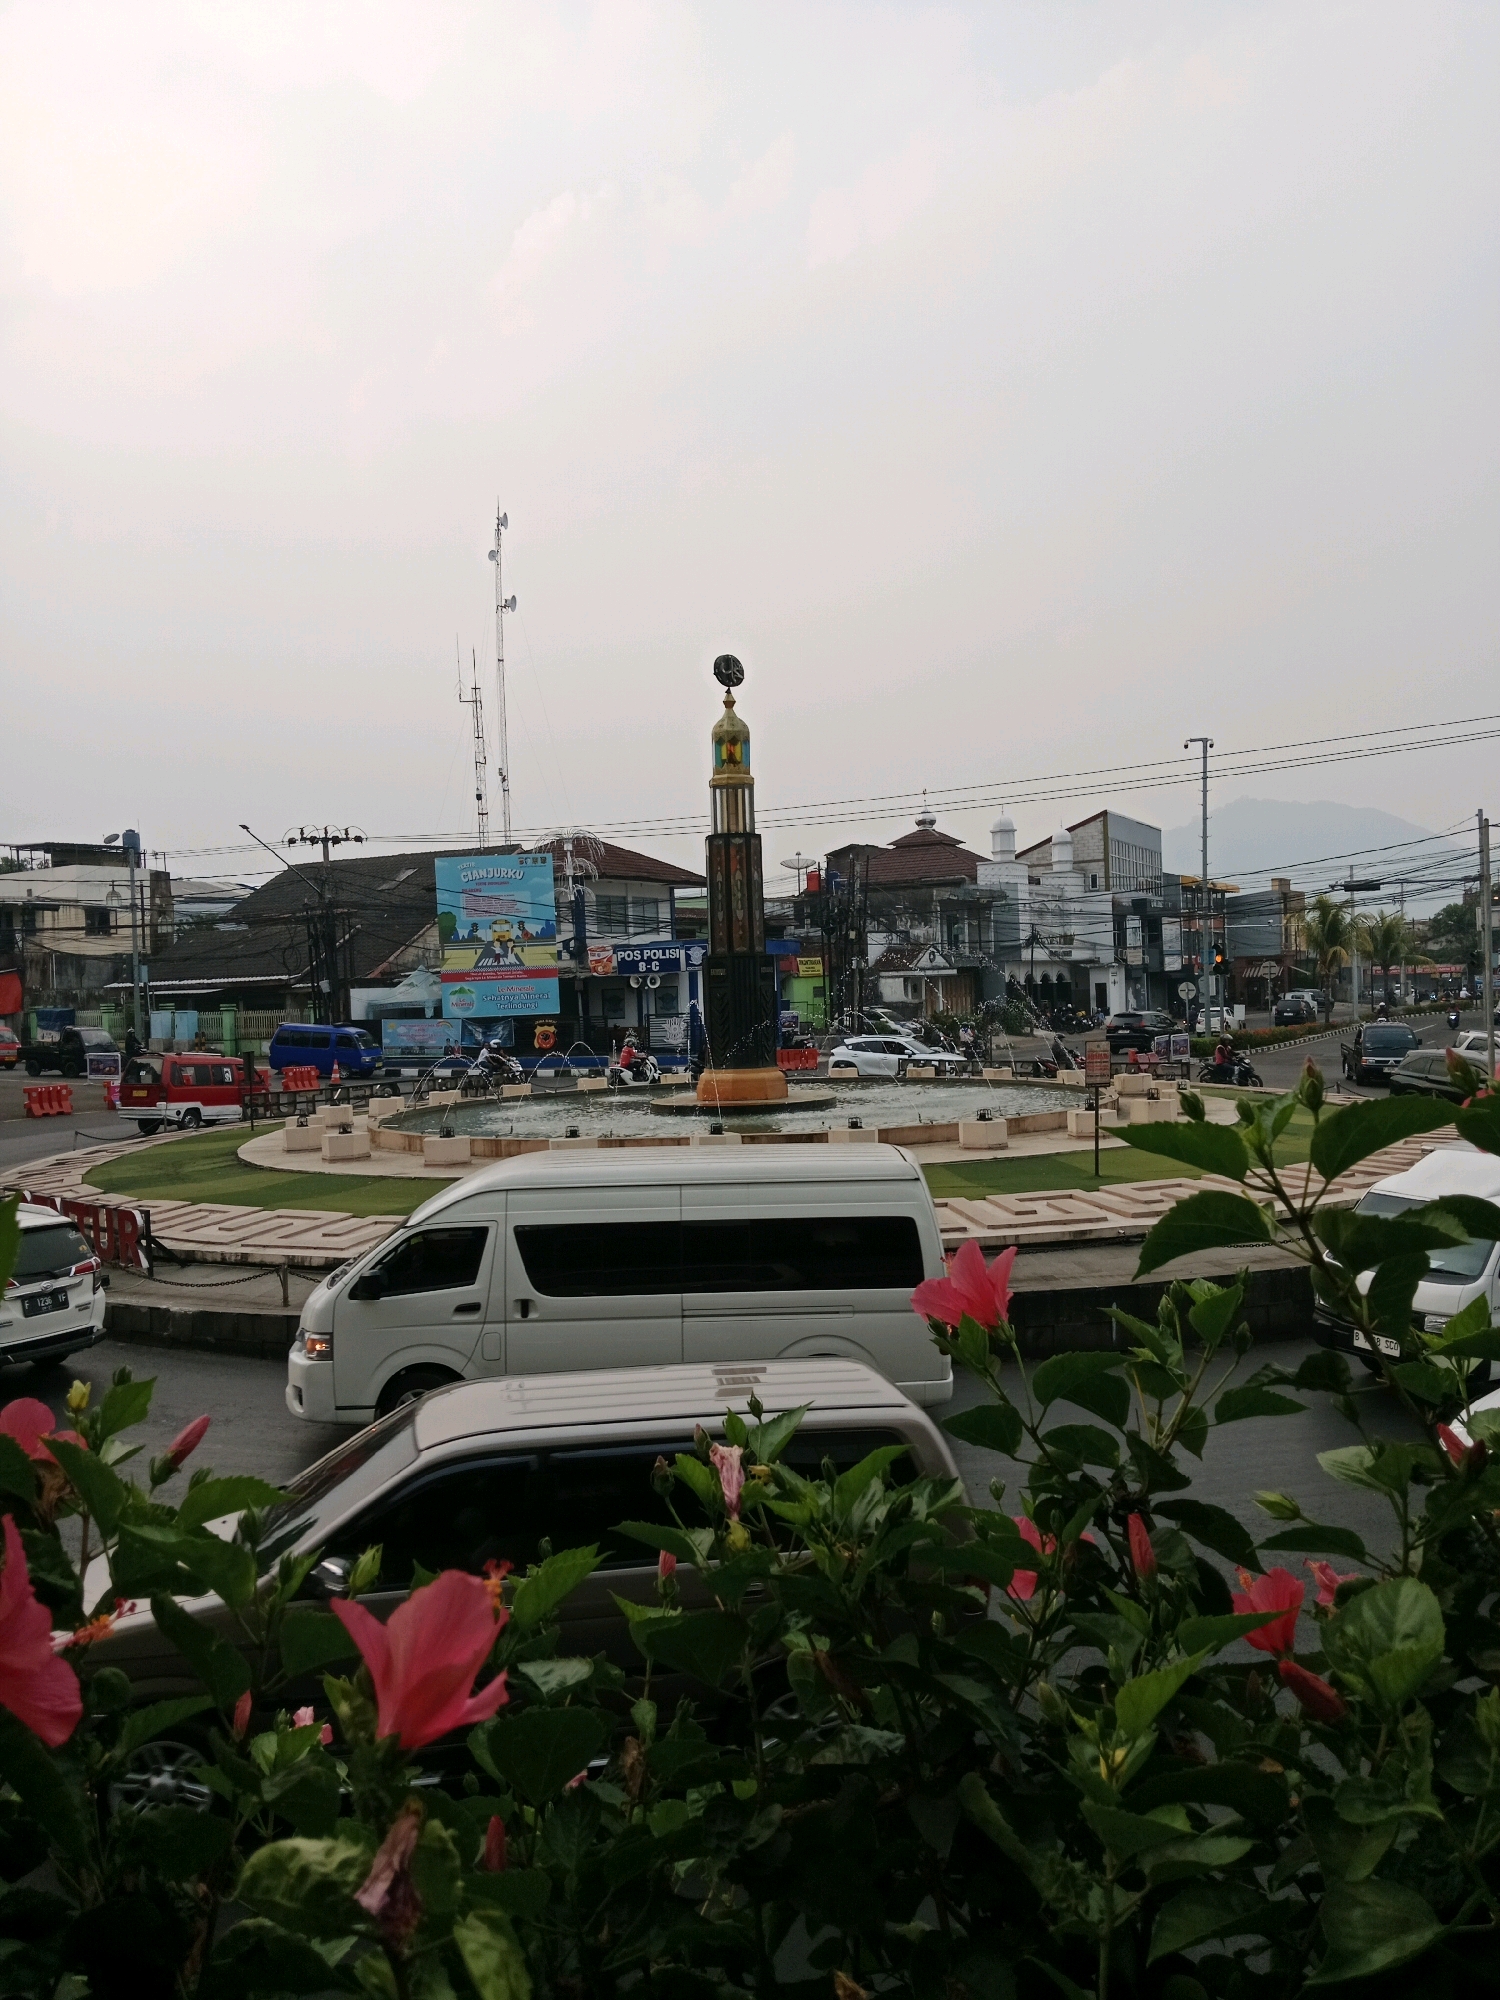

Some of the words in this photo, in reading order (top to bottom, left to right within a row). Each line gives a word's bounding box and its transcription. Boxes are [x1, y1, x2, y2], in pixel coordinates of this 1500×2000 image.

[460, 867, 525, 883] CIANJURKU
[617, 950, 641, 961] POS
[643, 948, 680, 960] POLISI
[638, 961, 660, 972] 8-C
[482, 994, 519, 1003] Sehatnya
[520, 992, 551, 1000] Mineral
[496, 1001, 538, 1010] Terlindungi
[24, 1299, 30, 1310] F
[37, 1296, 53, 1307] 1236
[1355, 1331, 1360, 1341] B
